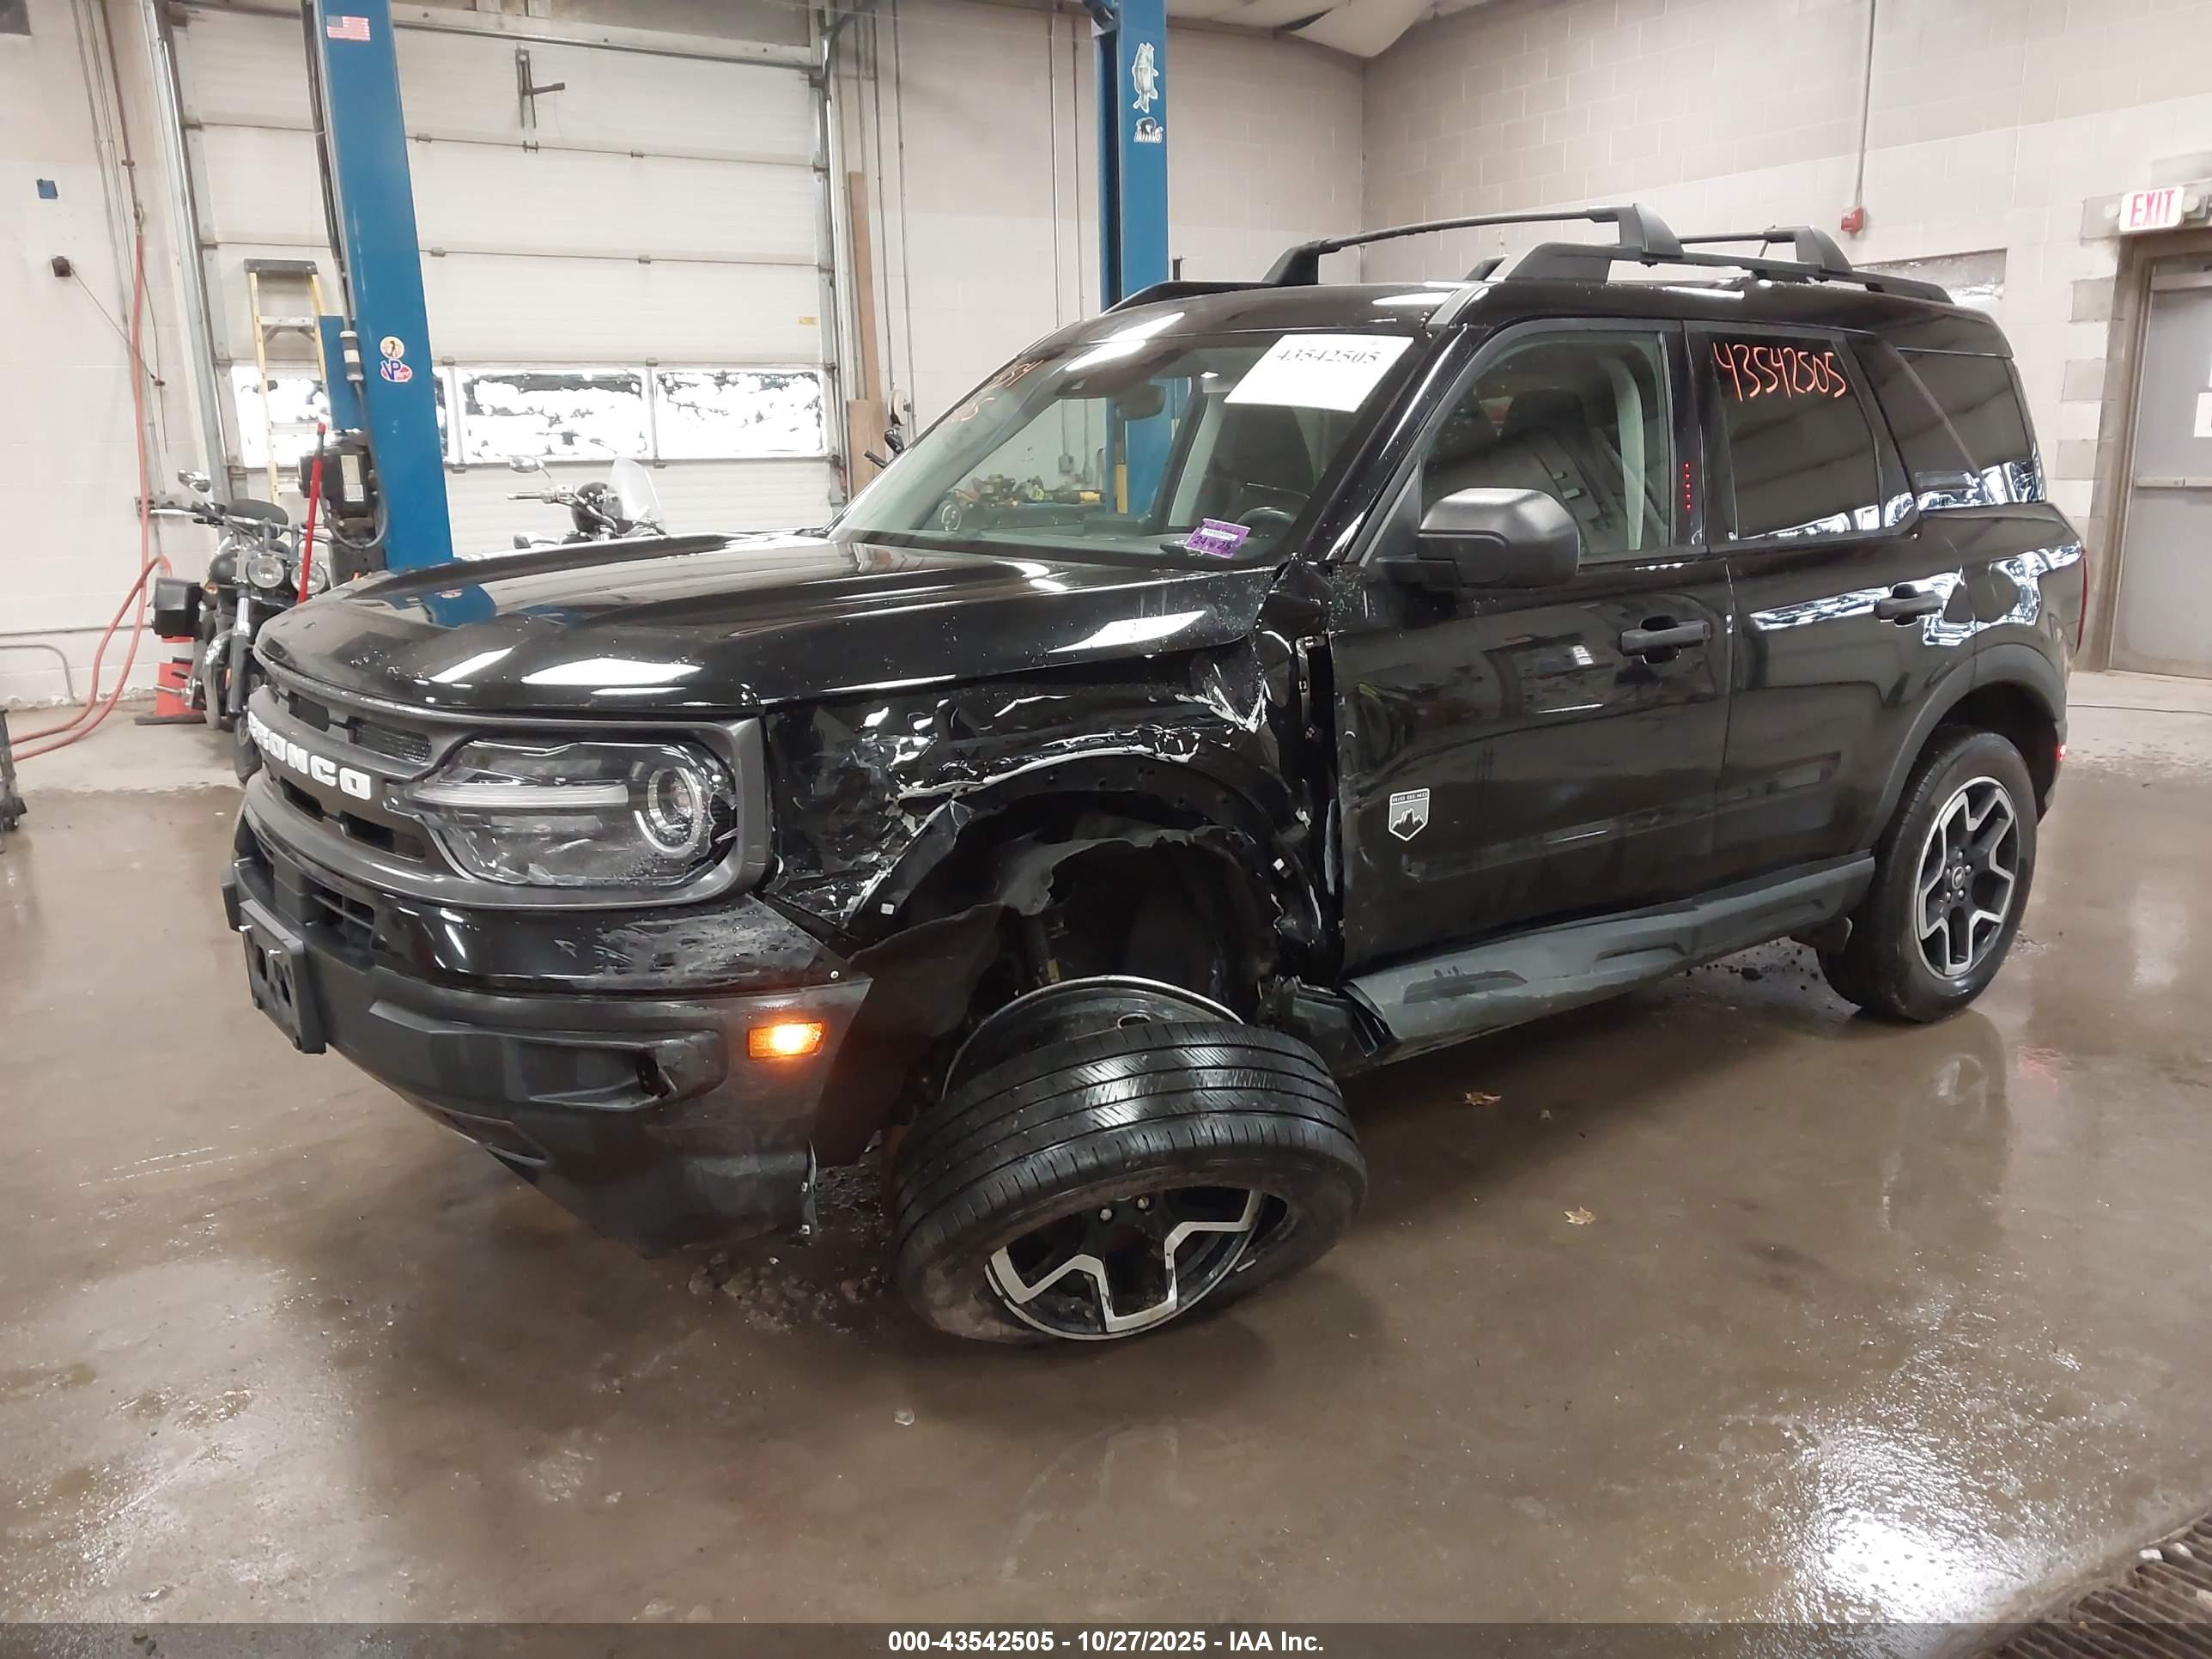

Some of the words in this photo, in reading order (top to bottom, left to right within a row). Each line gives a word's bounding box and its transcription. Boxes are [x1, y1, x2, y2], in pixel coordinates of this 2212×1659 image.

[2130, 190, 2175, 227] EXIT
[1276, 349, 1382, 365] 43542505
[1712, 341, 1847, 402] 43542505
